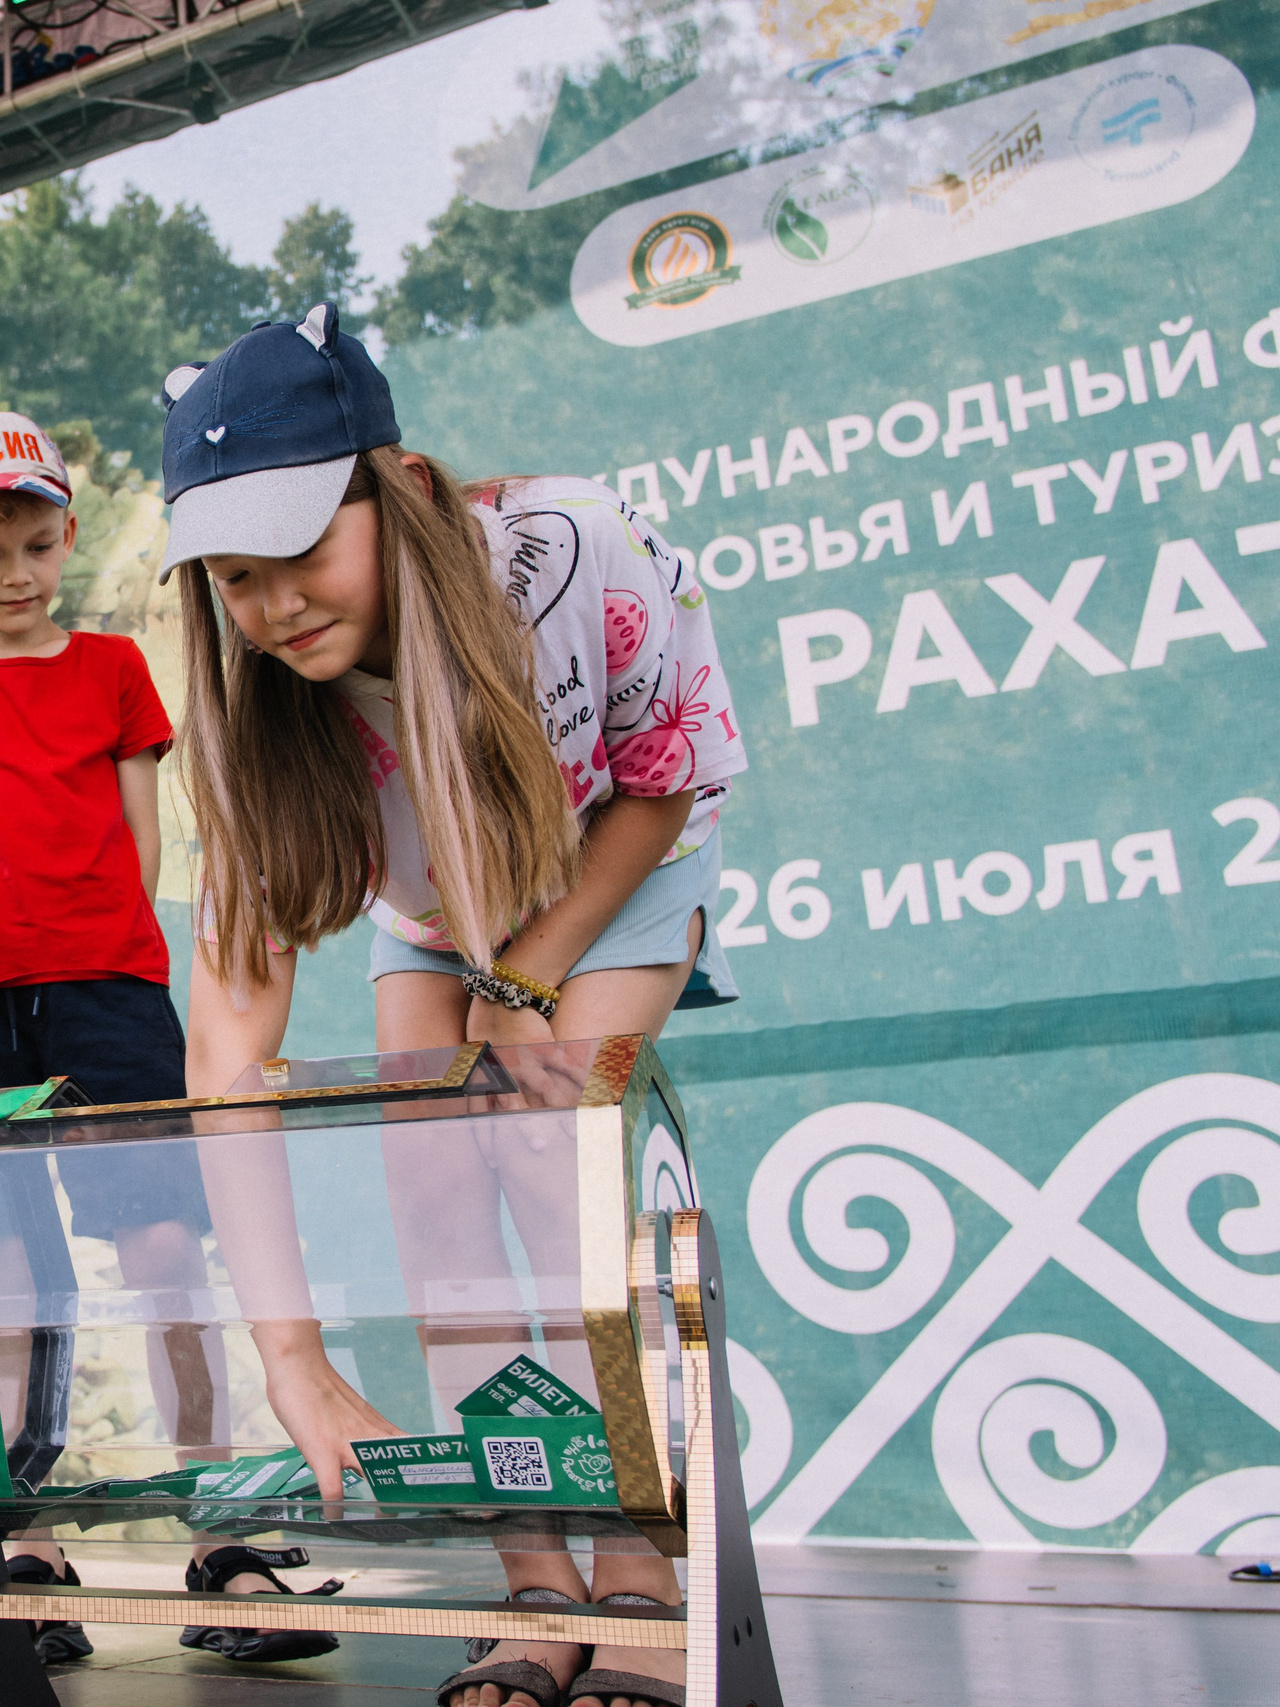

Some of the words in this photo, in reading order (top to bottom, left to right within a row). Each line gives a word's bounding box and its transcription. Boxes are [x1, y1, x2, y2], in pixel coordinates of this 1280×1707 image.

[970, 121, 1042, 197] БАНЯ
[593, 315, 1219, 523] ДУНАРОДНЫЙ
[931, 480, 994, 547] И
[546, 705, 596, 747] love
[715, 857, 832, 949] 26
[488, 1388, 506, 1404] ТЕЛ.
[496, 1382, 518, 1398] ФИО
[507, 1361, 572, 1407] БИЛЕТ
[357, 1443, 422, 1461] БИЛЕТ
[426, 1441, 469, 1457] №7
[373, 1467, 396, 1476] ФИО
[376, 1477, 398, 1485] ТЕЛ.
[246, 1547, 283, 1561] FASHION
